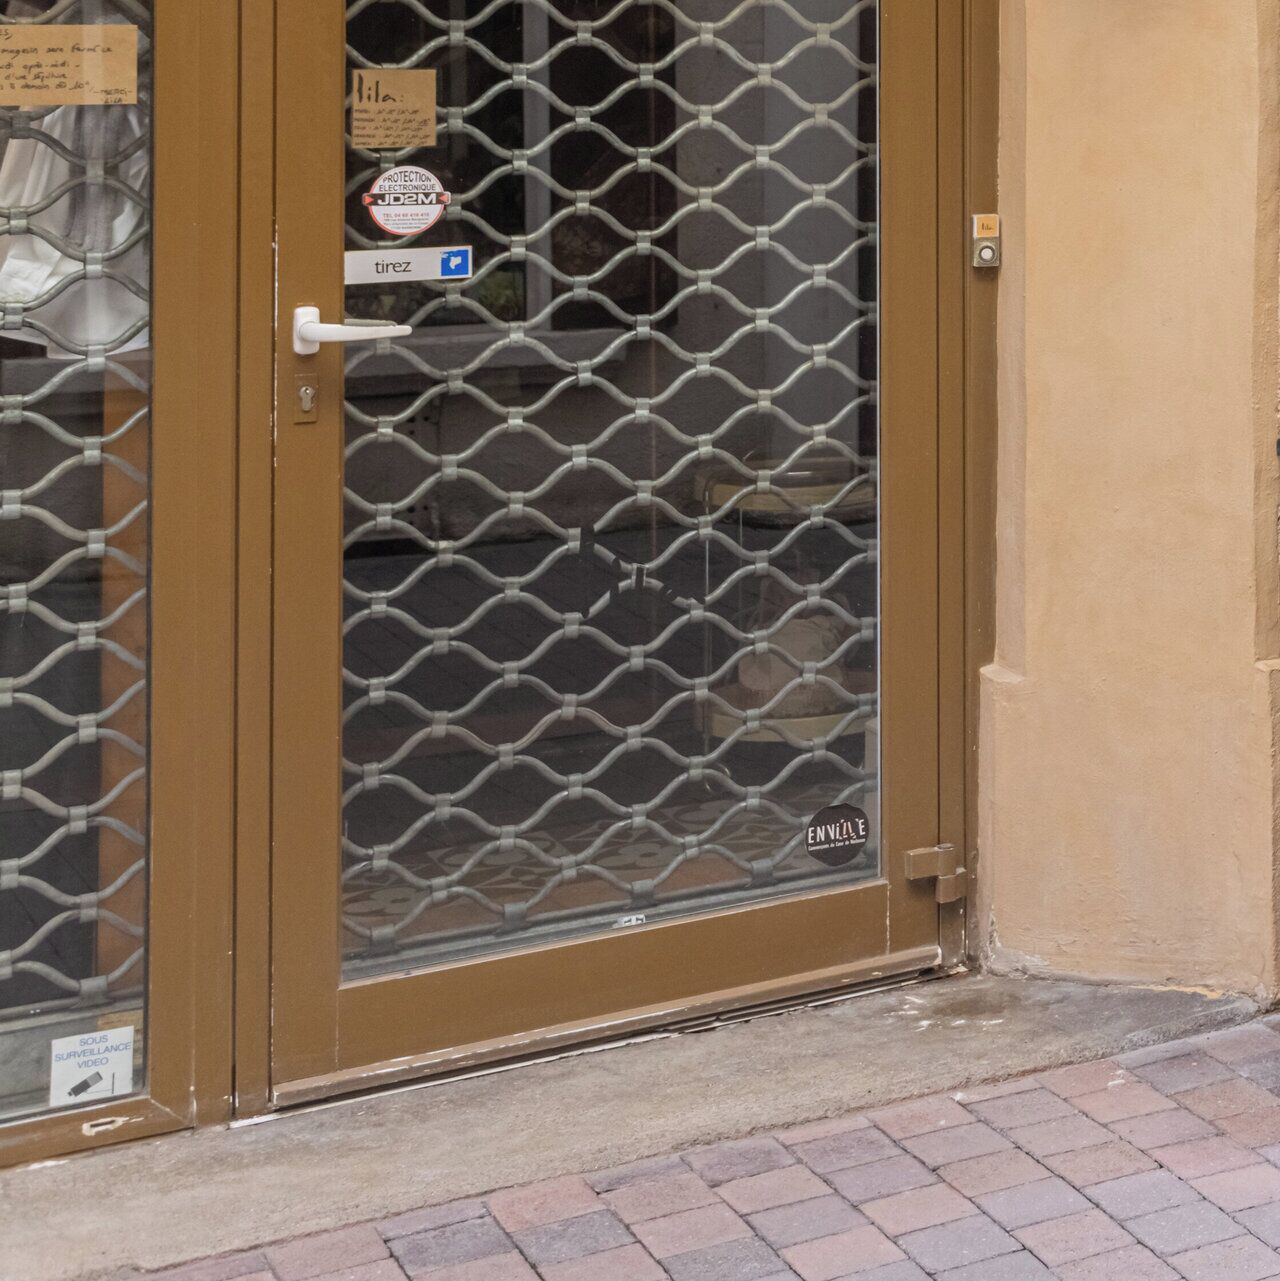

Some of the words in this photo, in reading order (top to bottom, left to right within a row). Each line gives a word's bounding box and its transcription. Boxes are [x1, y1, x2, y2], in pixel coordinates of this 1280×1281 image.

[383, 170, 432, 184] PROTECTION
[379, 184, 436, 192] ELECTRONIQUE
[377, 193, 437, 205] JD2M
[374, 260, 412, 274] tirez
[80, 1034, 108, 1046] SOUS
[54, 1041, 131, 1062] SURVEILLANCE
[77, 1057, 108, 1068] VIDEO
